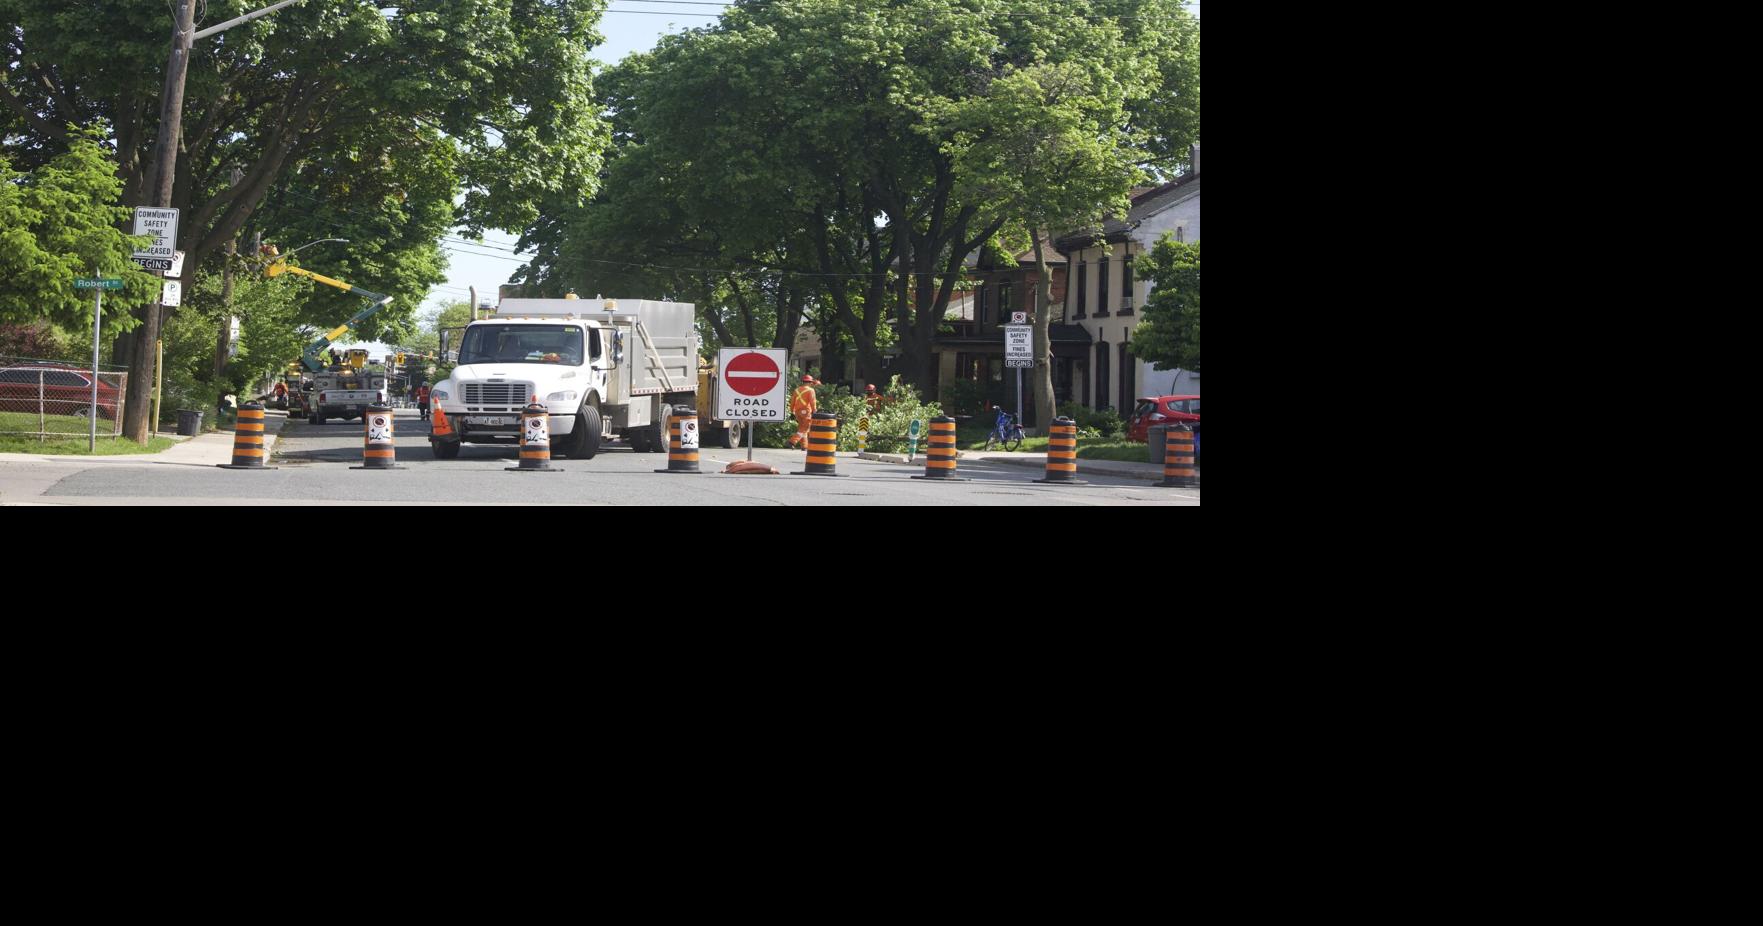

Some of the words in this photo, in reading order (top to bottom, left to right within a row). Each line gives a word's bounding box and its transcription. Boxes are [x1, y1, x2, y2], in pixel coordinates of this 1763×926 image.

[138, 210, 175, 219] COMMUNITY
[144, 220, 168, 228] SAFETY
[77, 279, 110, 287] Robert
